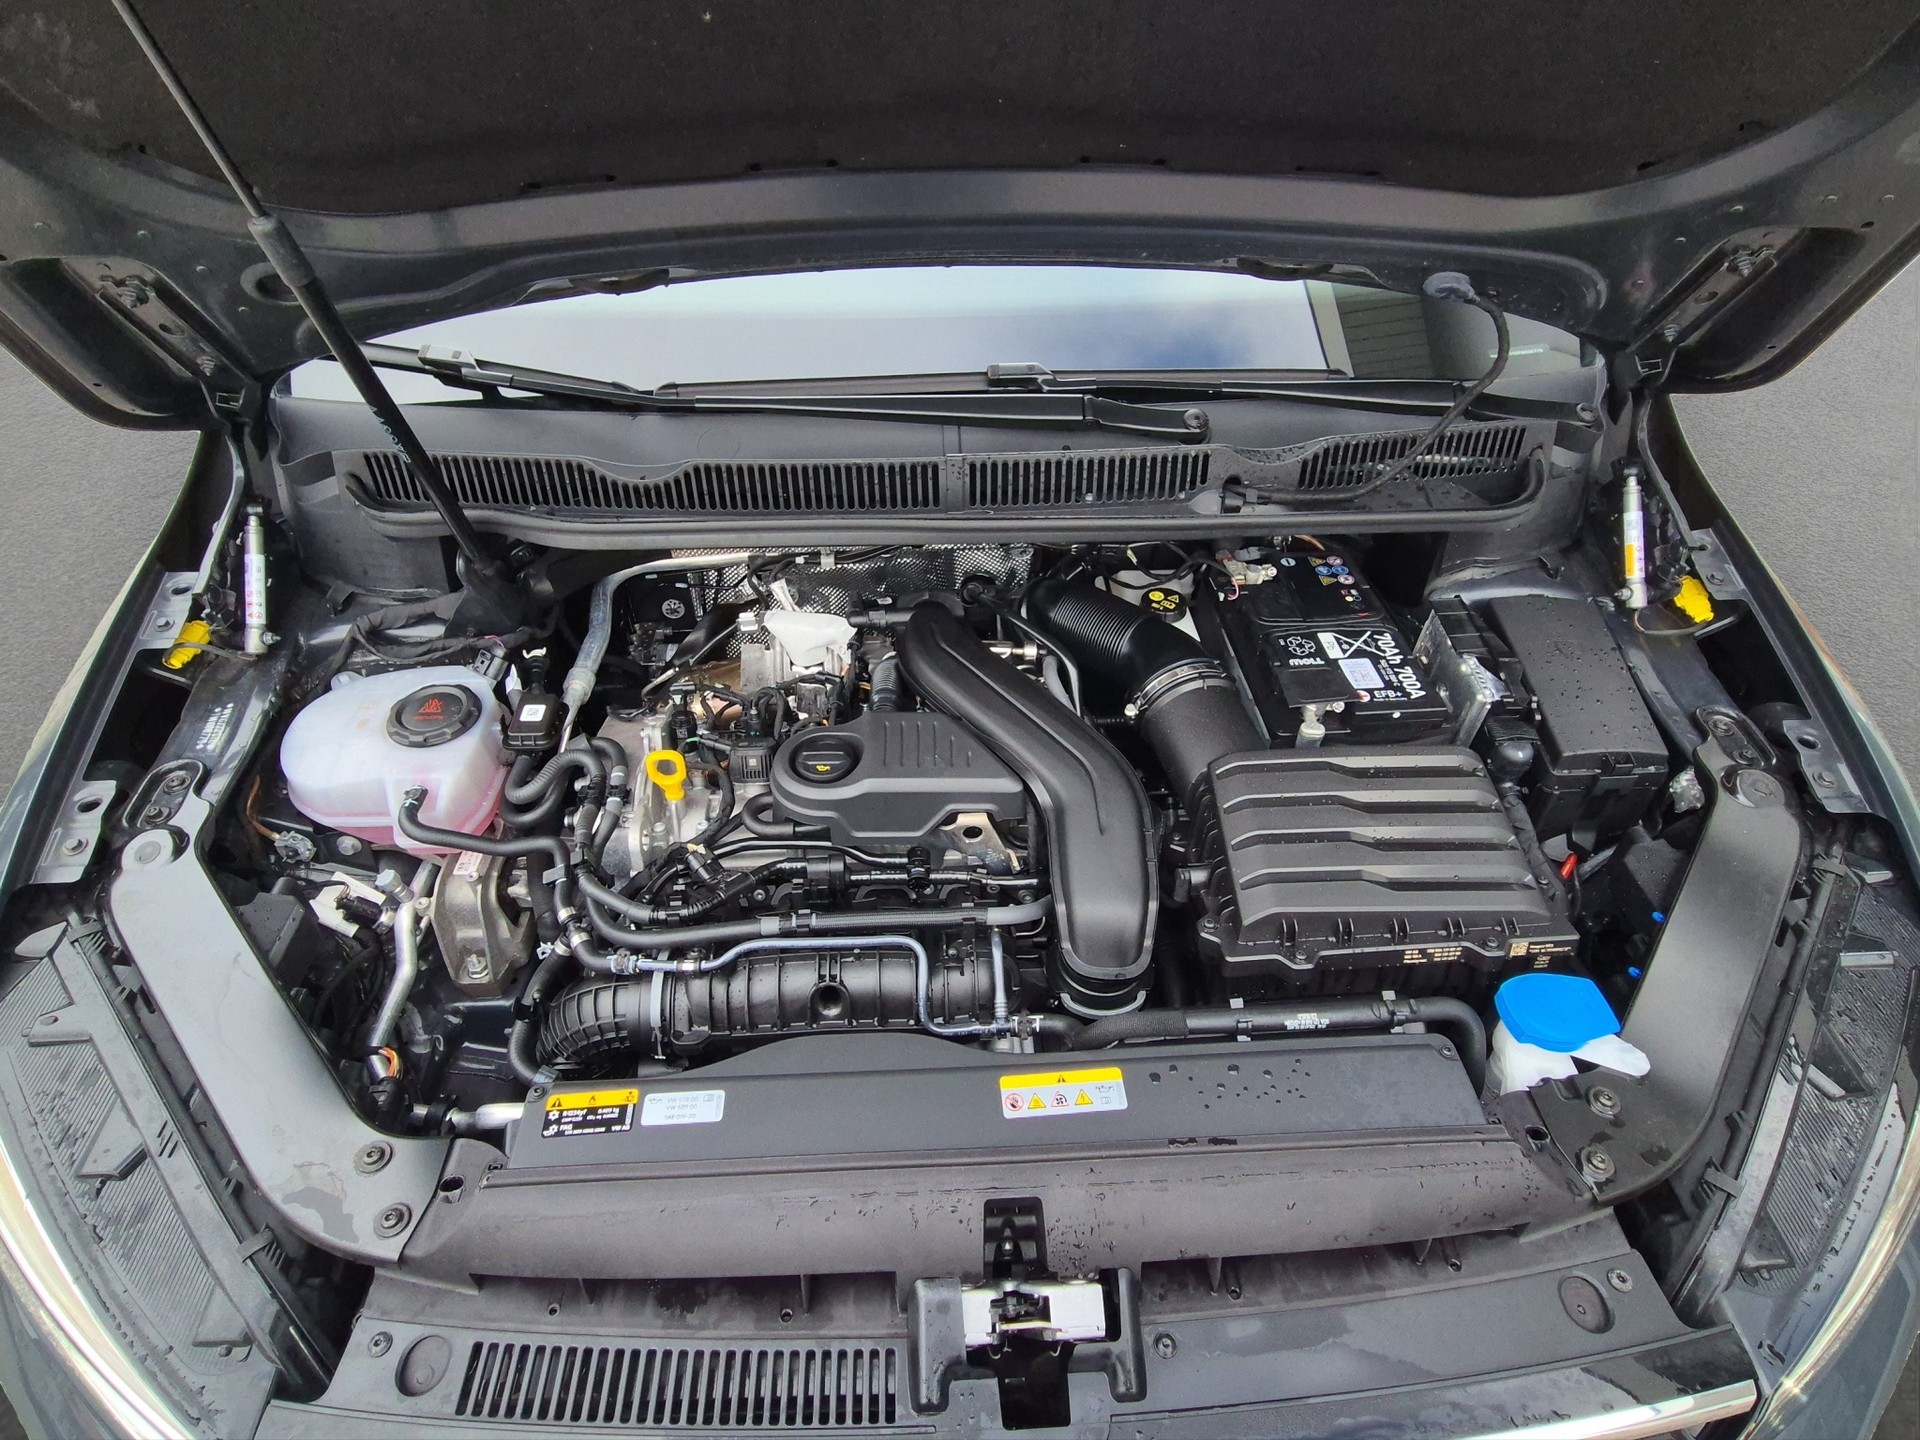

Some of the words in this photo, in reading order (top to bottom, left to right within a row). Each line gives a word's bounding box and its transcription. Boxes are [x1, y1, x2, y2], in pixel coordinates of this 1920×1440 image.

[1373, 632, 1404, 665] 70Ah
[1393, 665, 1427, 699] 700A
[1374, 690, 1403, 698] EFB+
